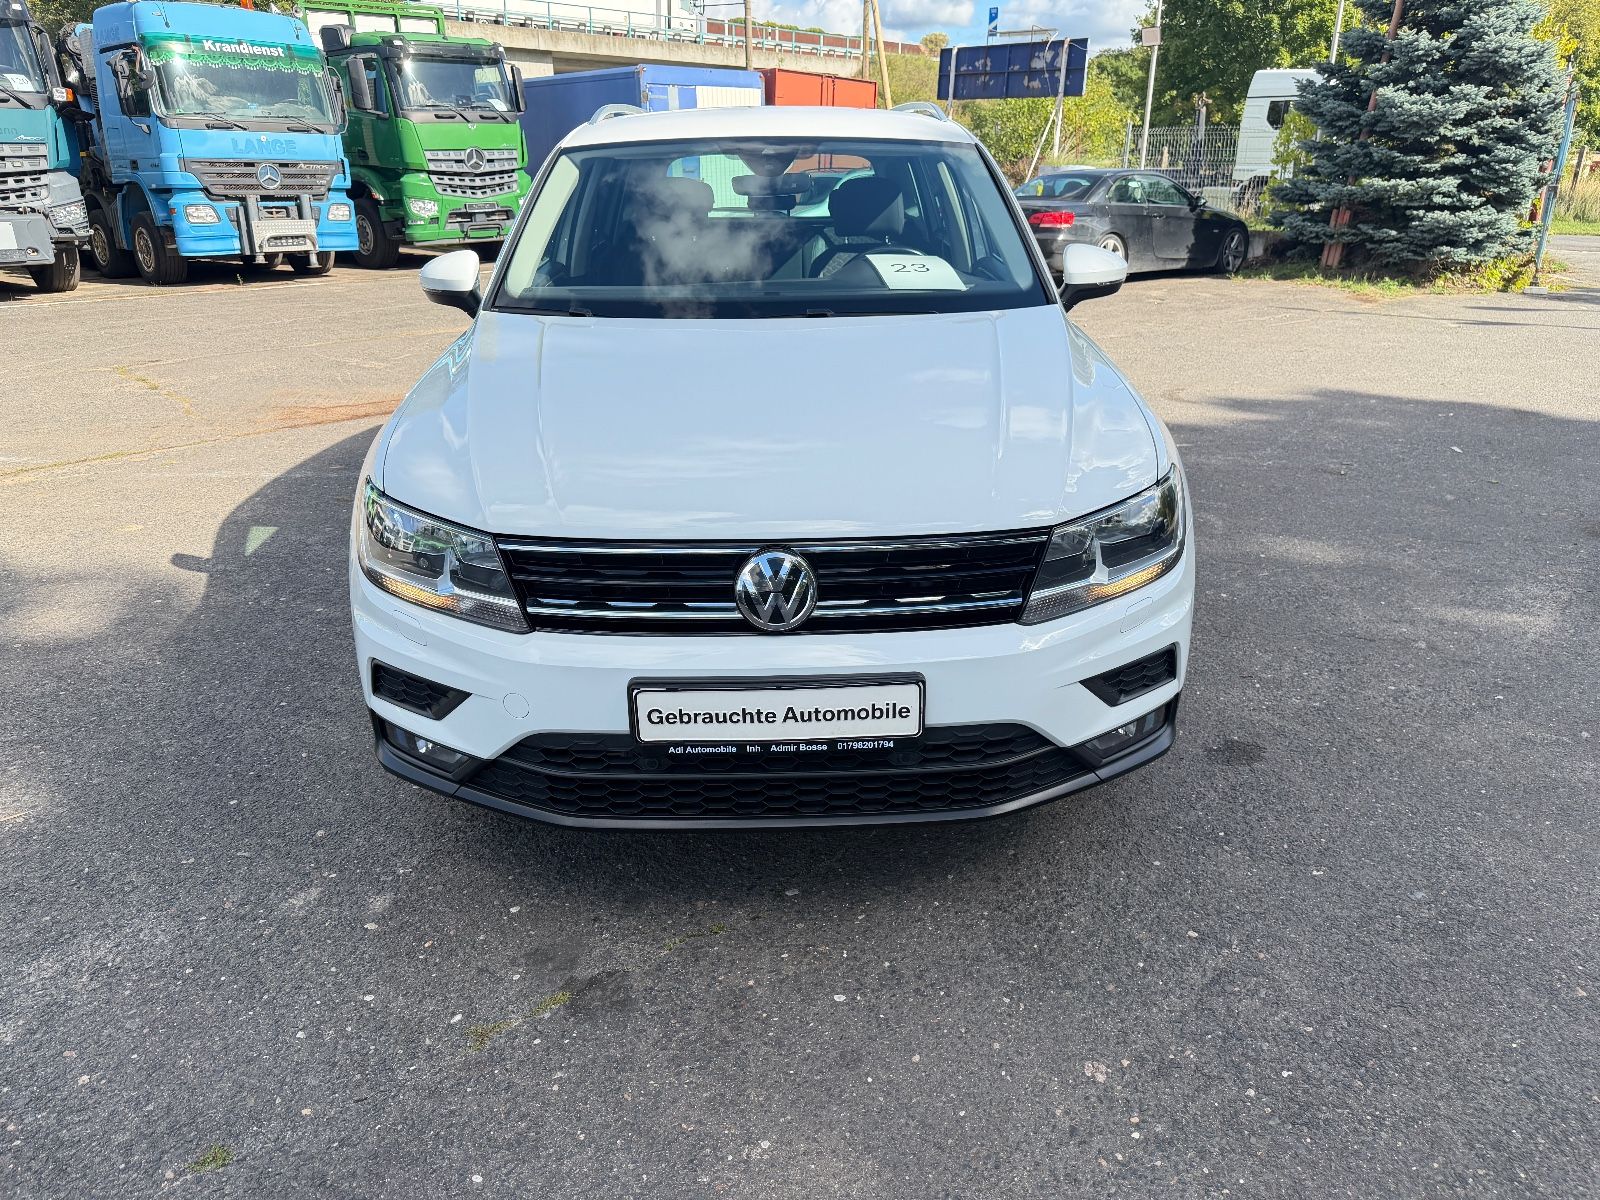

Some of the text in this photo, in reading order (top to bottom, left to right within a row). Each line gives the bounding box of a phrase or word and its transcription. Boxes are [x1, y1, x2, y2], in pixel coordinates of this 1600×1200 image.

[202, 39, 285, 57] Krandienst
[232, 138, 298, 155] LANGE
[890, 263, 930, 273] 23
[646, 702, 912, 726] Gebrauchte Automobile
[686, 744, 737, 754] Automobile
[747, 744, 763, 752] Inh.
[770, 743, 797, 752] Admir
[800, 742, 828, 751] Bosse
[837, 740, 895, 750] 01798201794
